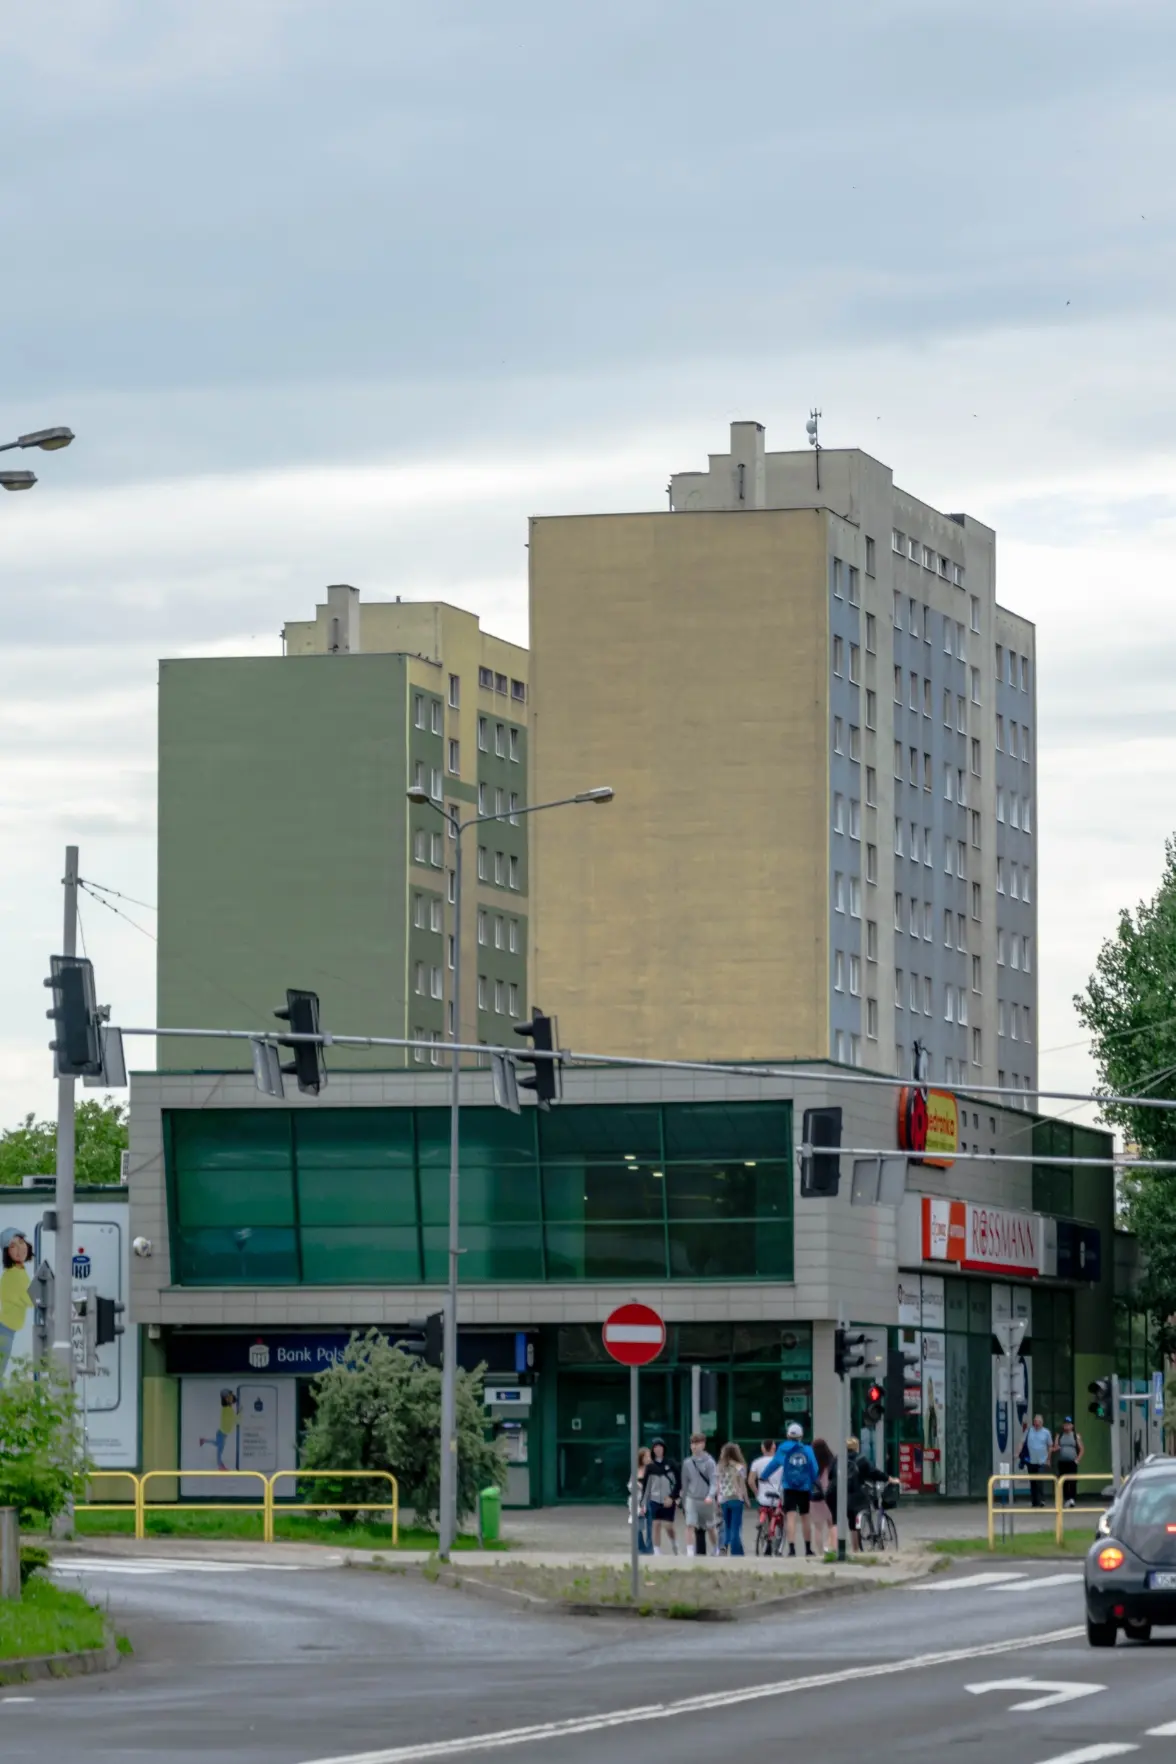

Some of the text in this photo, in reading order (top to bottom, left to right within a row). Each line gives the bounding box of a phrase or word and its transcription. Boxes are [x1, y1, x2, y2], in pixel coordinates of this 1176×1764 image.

[927, 1109, 955, 1137] edronka
[972, 1209, 1035, 1258] ROSSMANN
[277, 1346, 312, 1363] Bank
[317, 1346, 346, 1363] Pols
